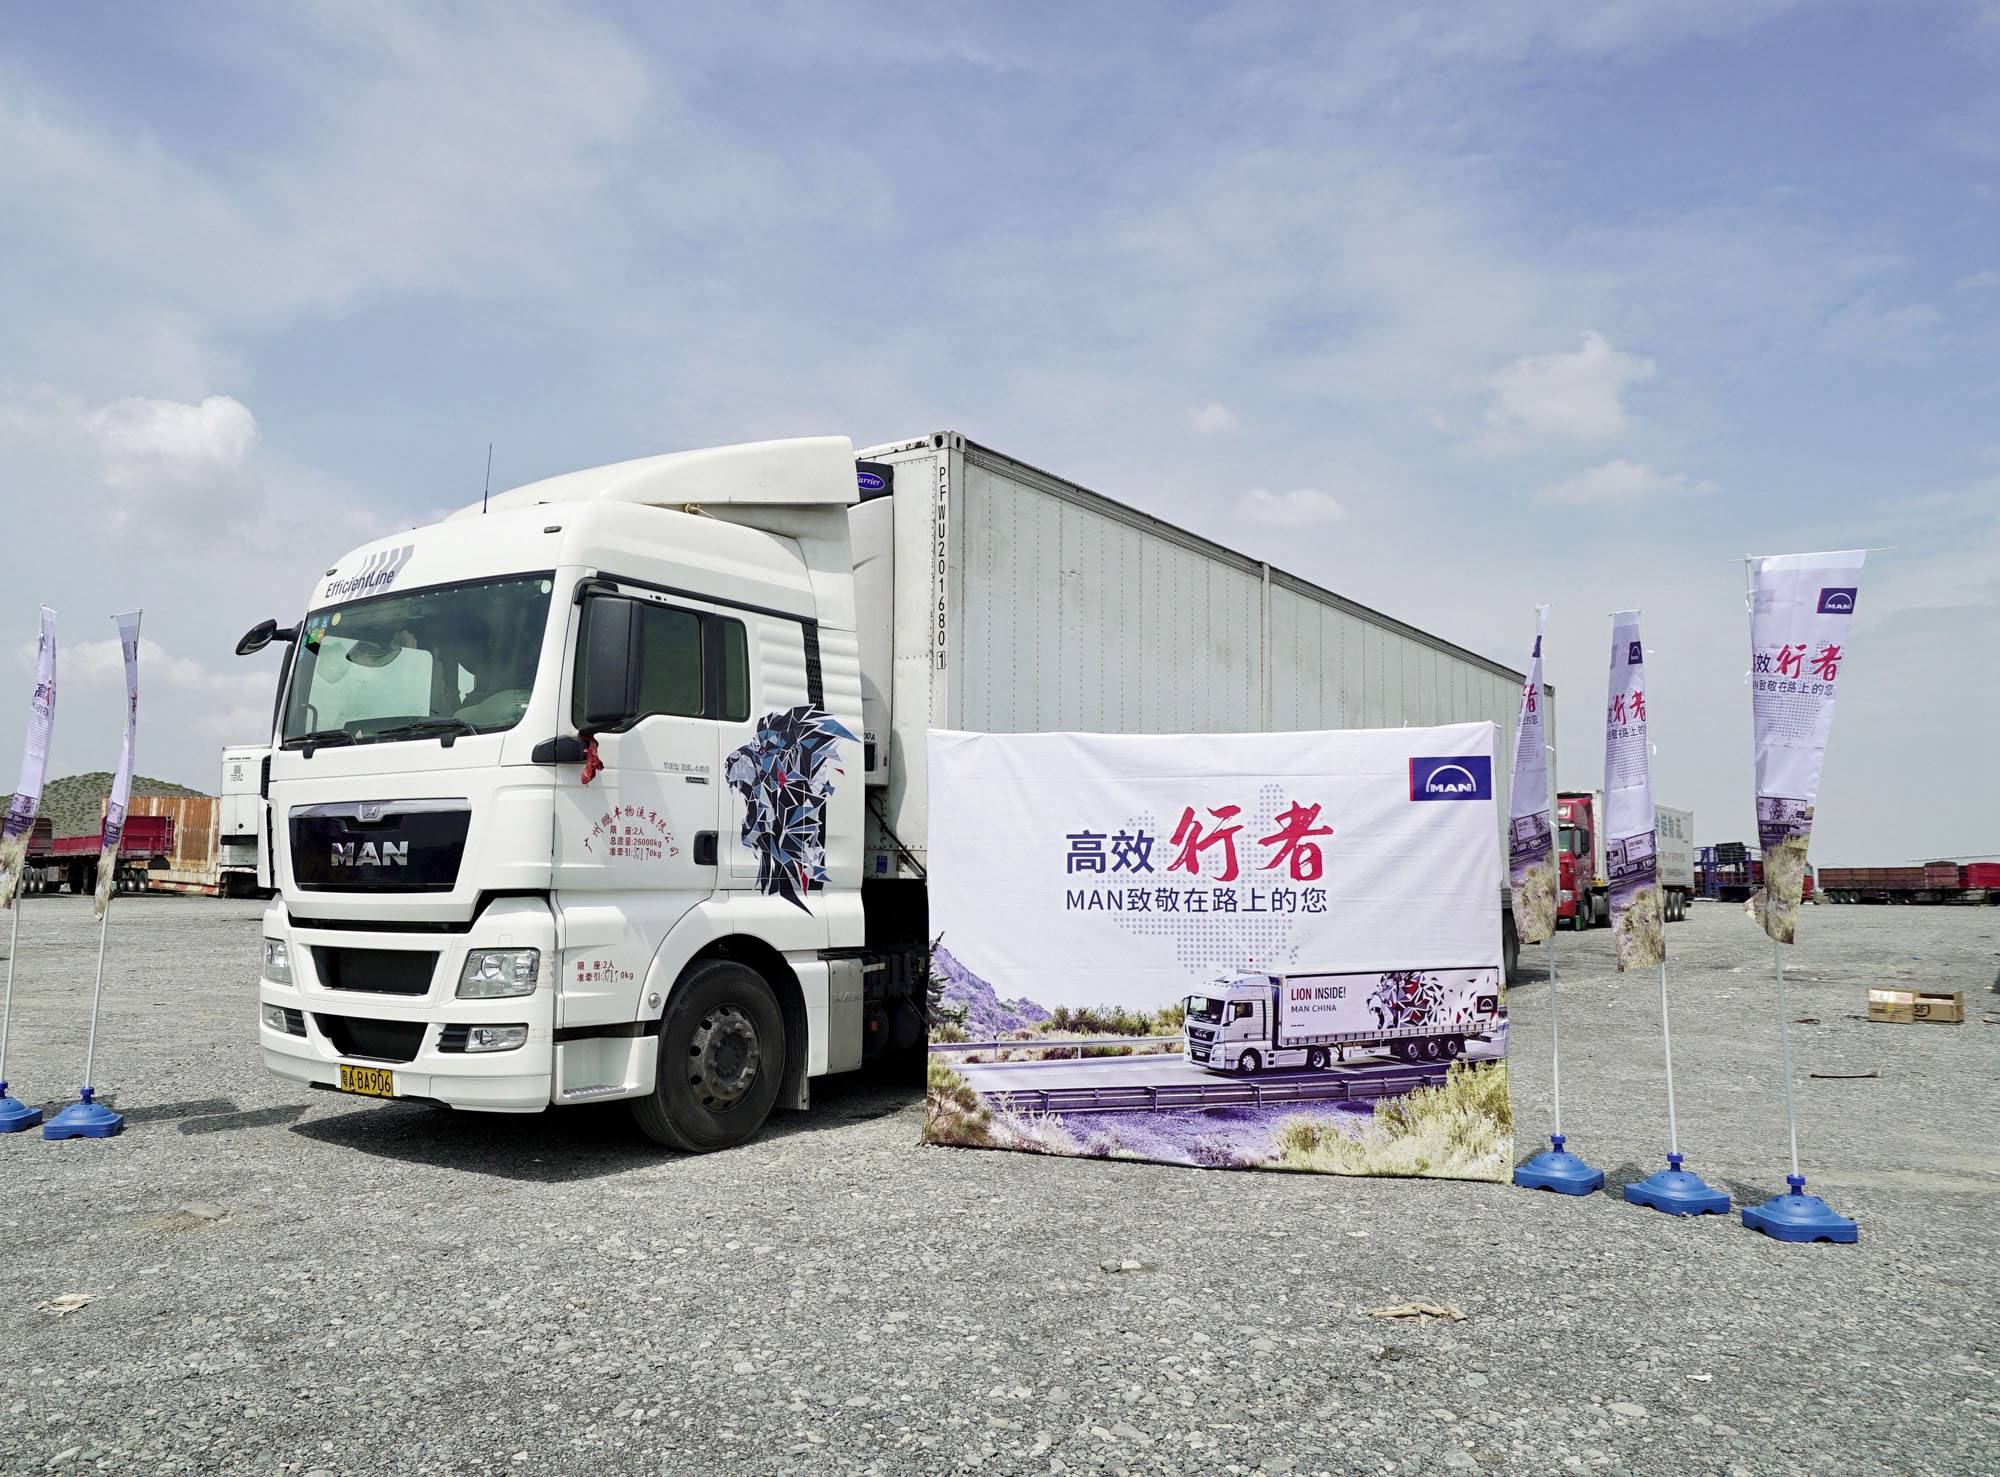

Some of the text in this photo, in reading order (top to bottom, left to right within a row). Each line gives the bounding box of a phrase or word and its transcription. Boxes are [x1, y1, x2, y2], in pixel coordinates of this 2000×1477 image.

[325, 569, 395, 599] EfficientLine
[1753, 643, 1842, 681] 效行者
[1429, 783, 1472, 793] MAN
[1066, 800, 1334, 881] 高效行者
[331, 841, 409, 867] MAN
[1066, 887, 1328, 913] MAN致敬在路上的您
[1291, 986, 1346, 1001] LION INSIDE!
[1291, 1004, 1337, 1013] MAN CHINA
